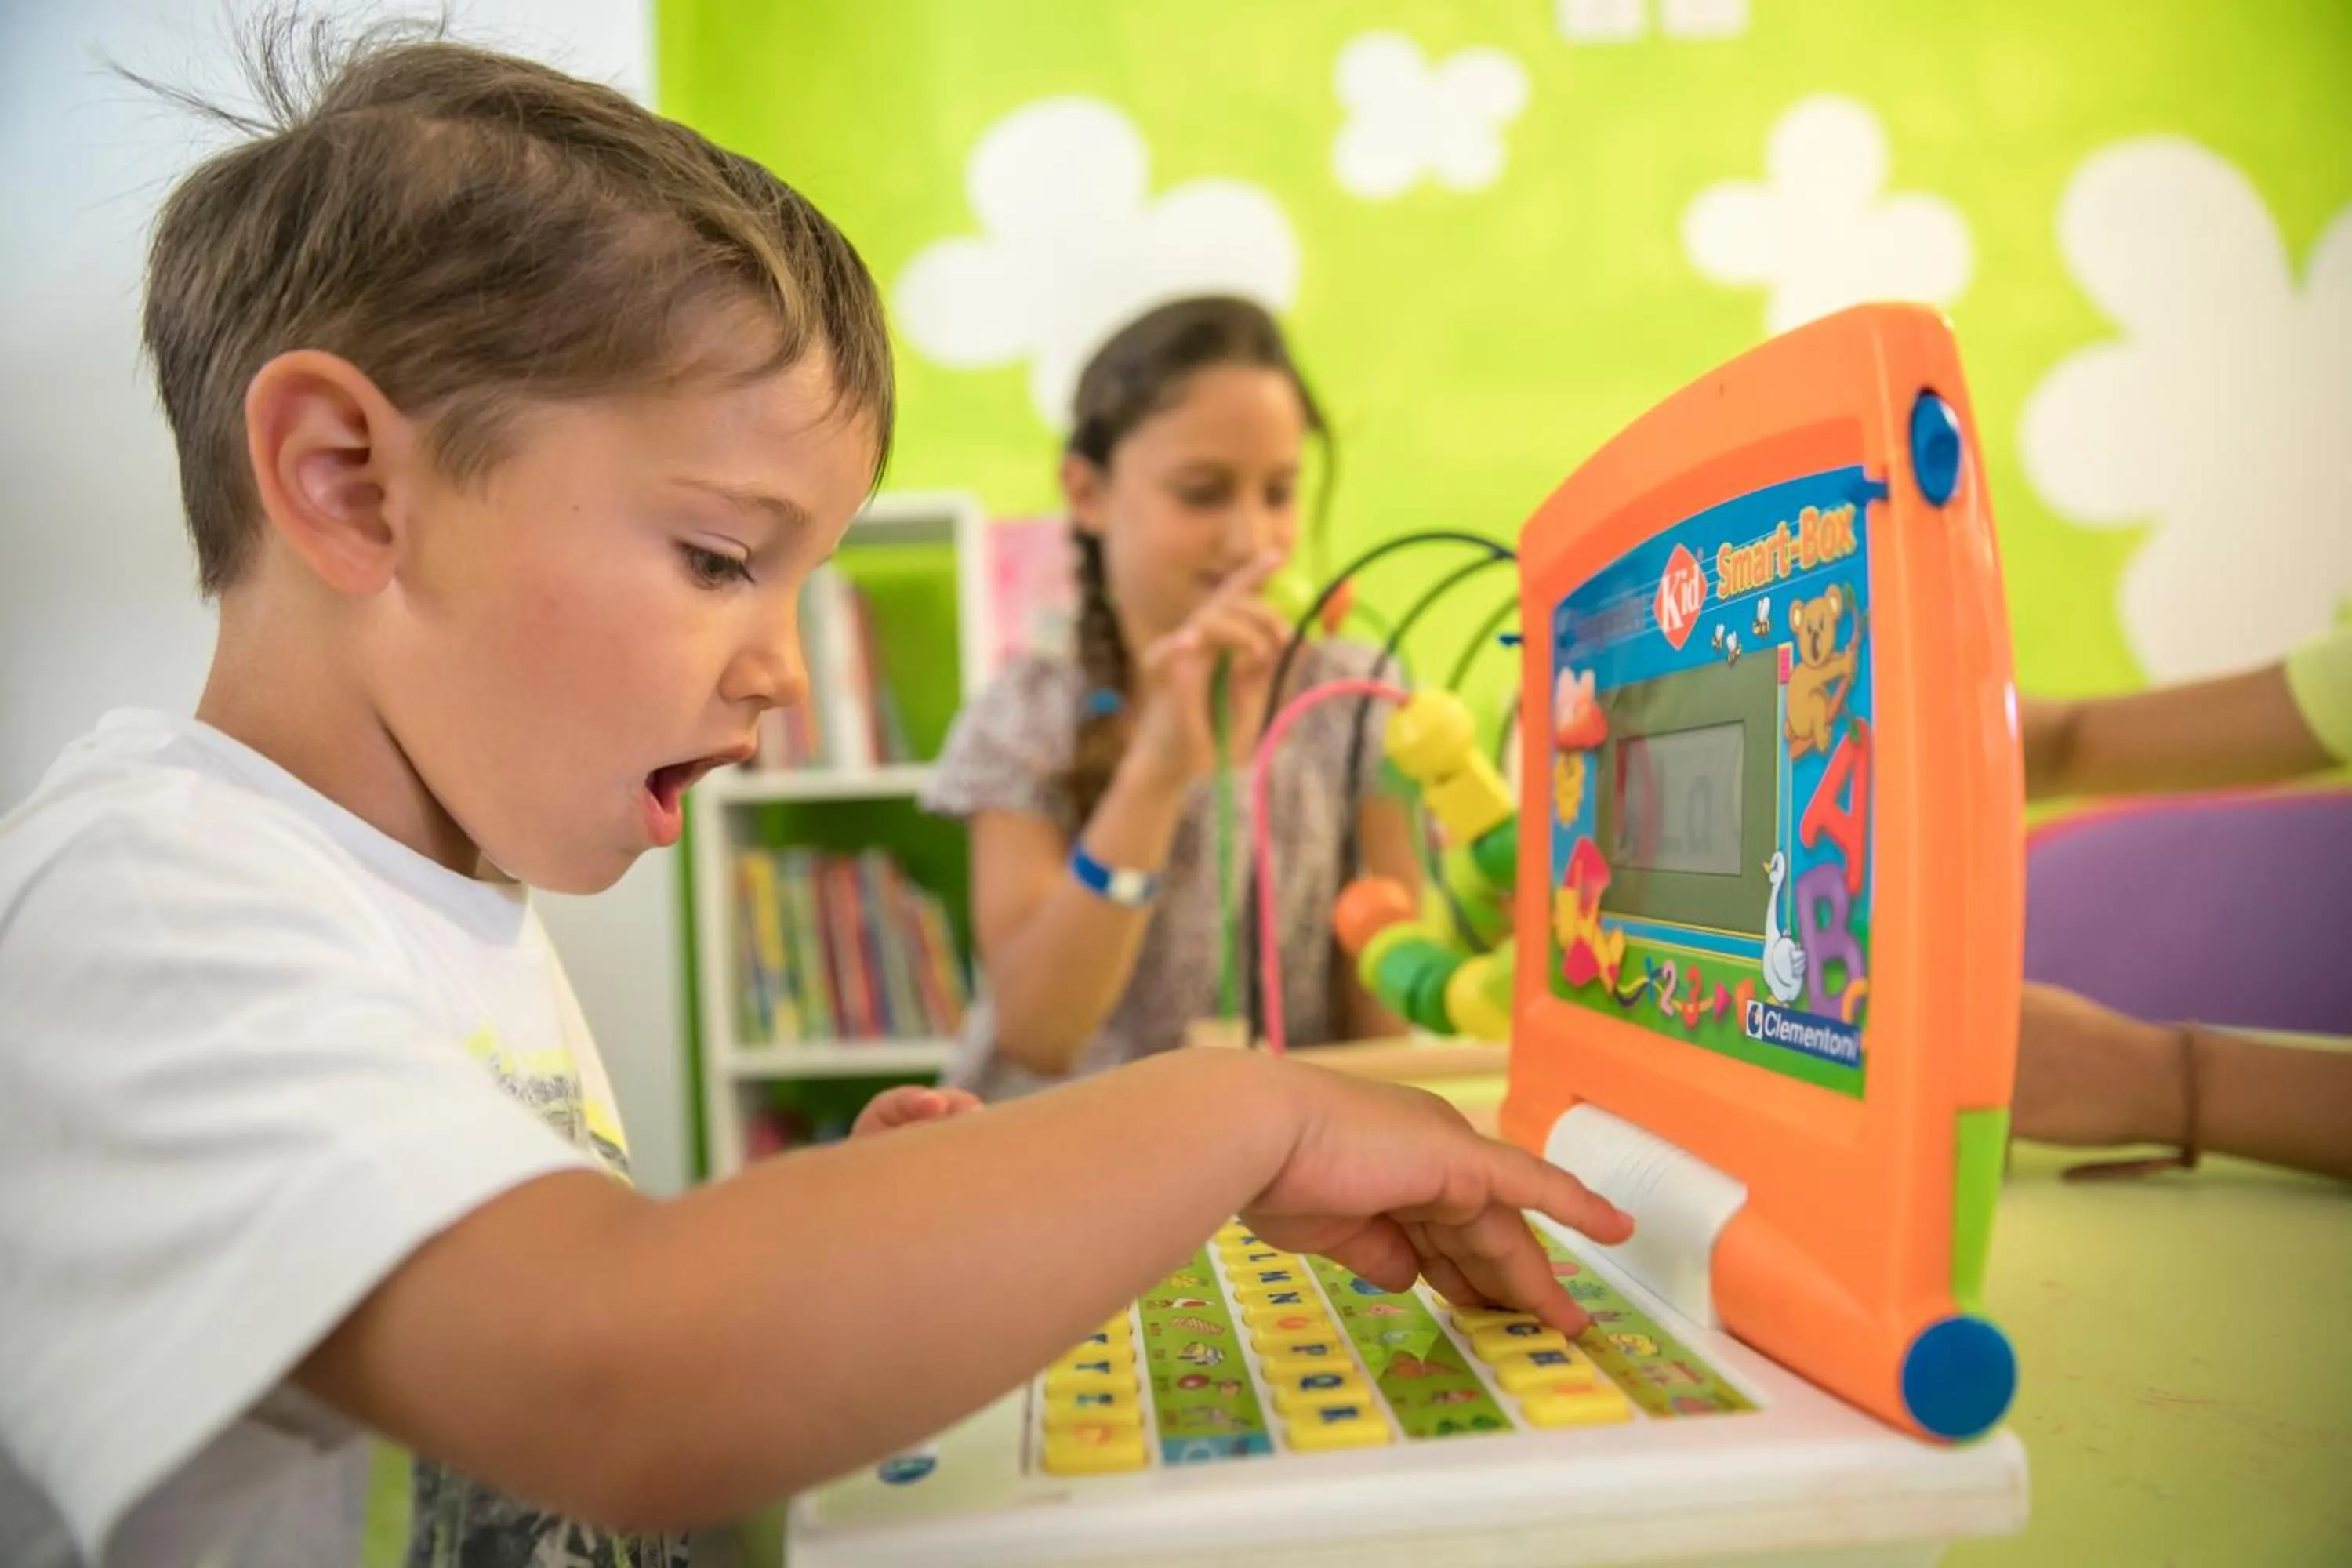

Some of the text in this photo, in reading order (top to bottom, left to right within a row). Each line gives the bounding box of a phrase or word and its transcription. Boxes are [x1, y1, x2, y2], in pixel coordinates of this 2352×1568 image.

[1661, 502, 1857, 633] Kid Smart-Box
[1800, 717, 1870, 895] A
[1764, 1010, 1858, 1061] Clementoni
